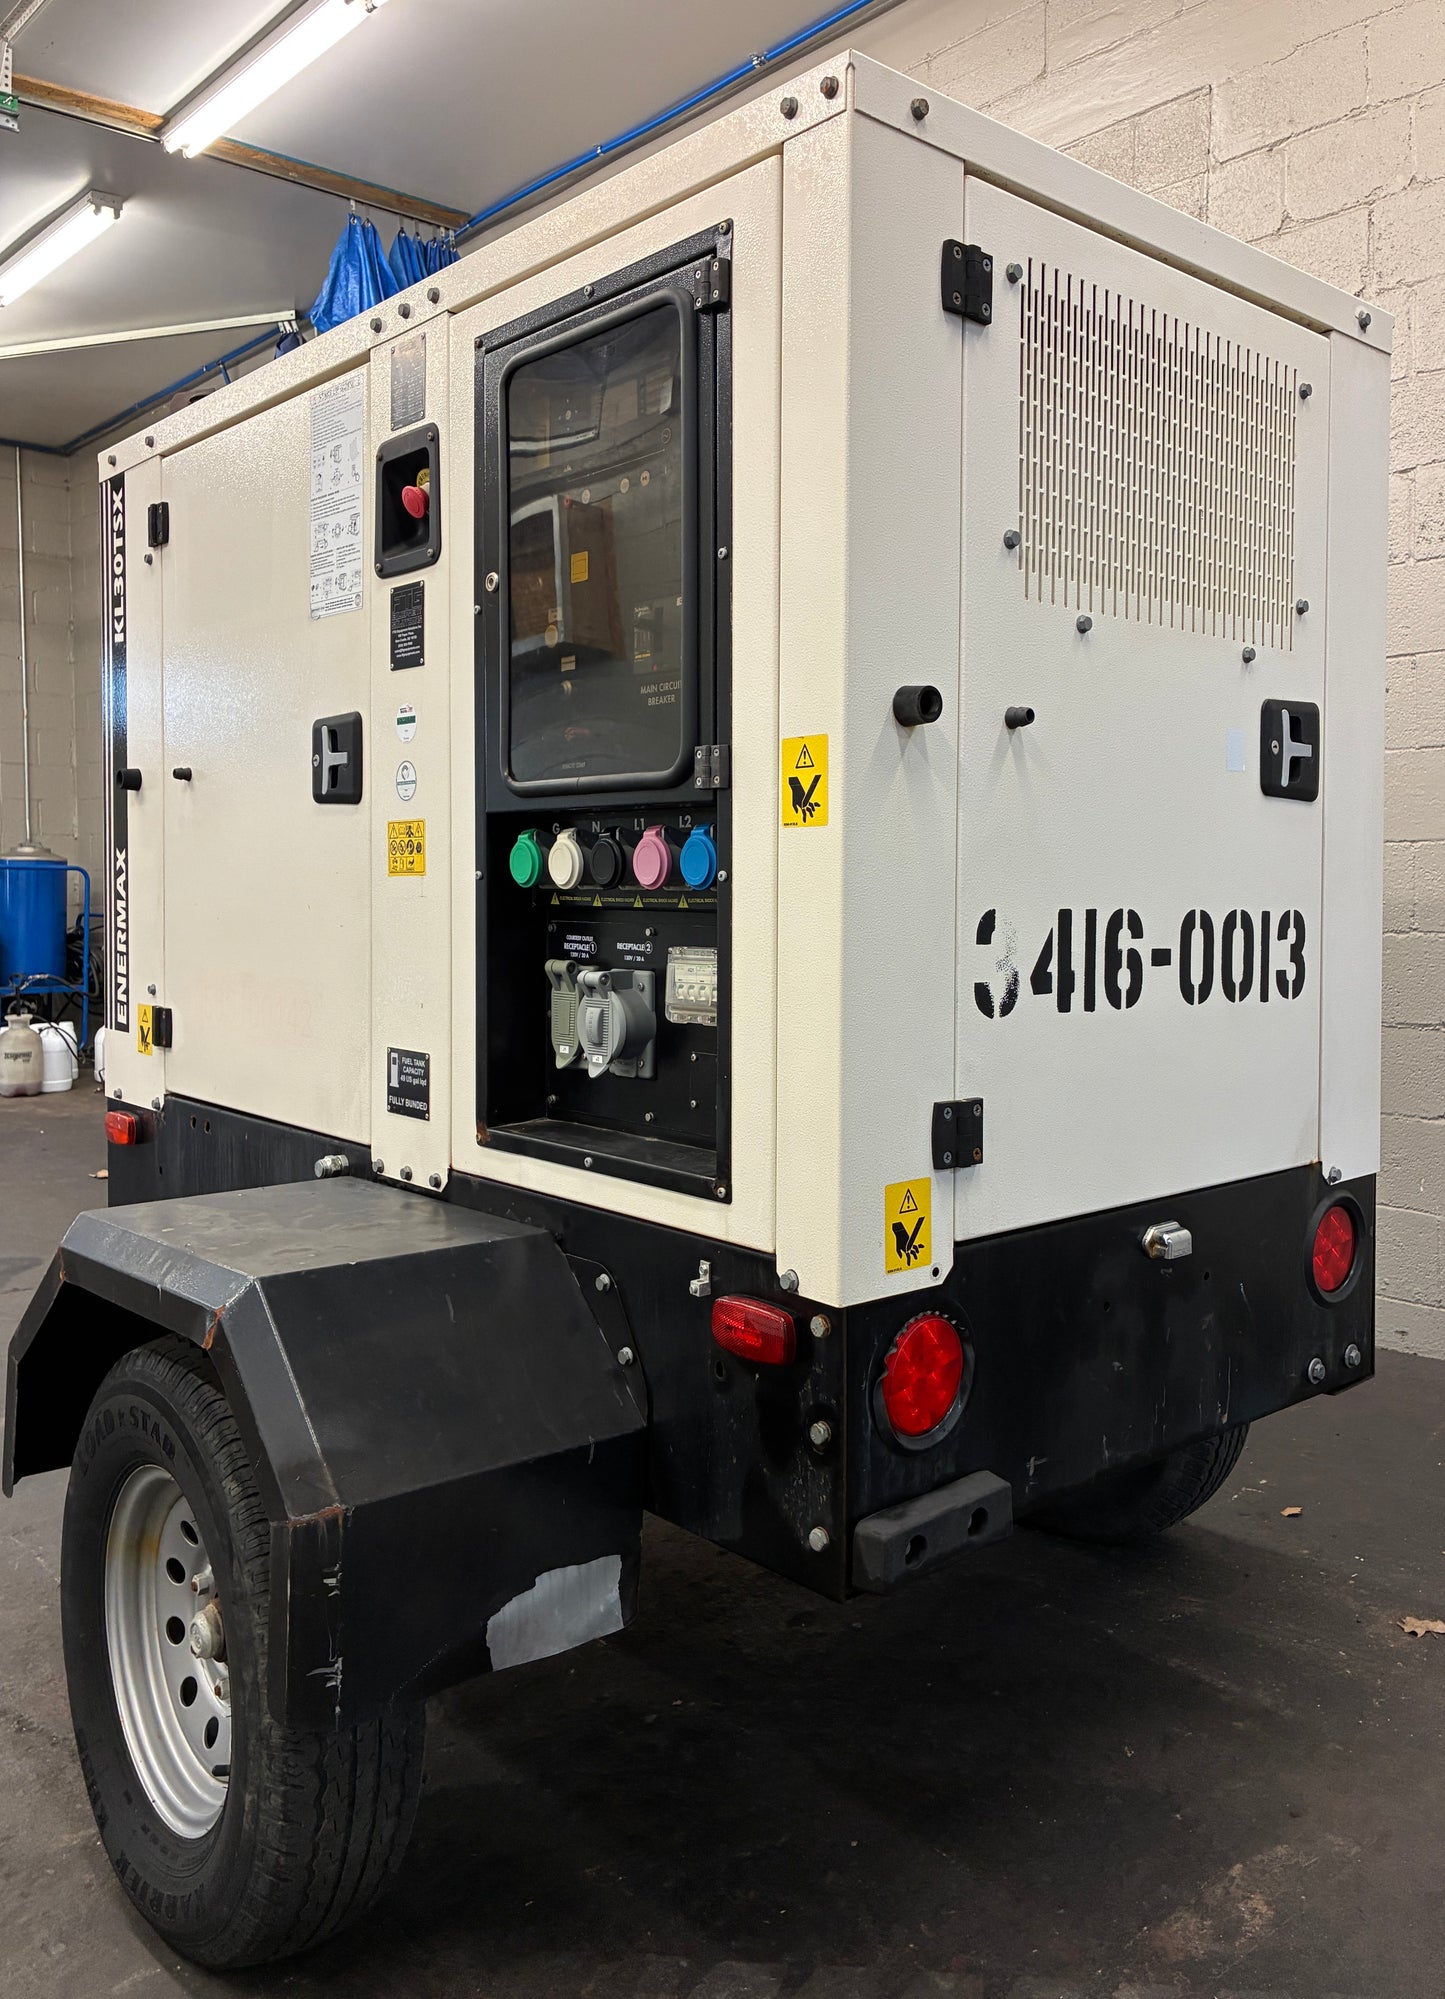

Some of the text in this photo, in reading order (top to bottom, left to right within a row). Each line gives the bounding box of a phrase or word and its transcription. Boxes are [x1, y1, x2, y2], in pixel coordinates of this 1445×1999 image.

[113, 487, 125, 643] KL30TSX
[640, 683, 658, 694] MAIN
[647, 694, 675, 706] BREAKER
[552, 815, 692, 834] G N L1 L2
[116, 848, 127, 1025] ENERMAX
[563, 942, 590, 951] RECEPTACLE
[616, 942, 645, 952] RECEPTACLE
[973, 908, 1306, 1019] 3416-0013
[401, 1056, 426, 1068] FUEL TANK
[402, 1066, 425, 1076] CAPACITY
[388, 1095, 428, 1111] FULLY BUNDED
